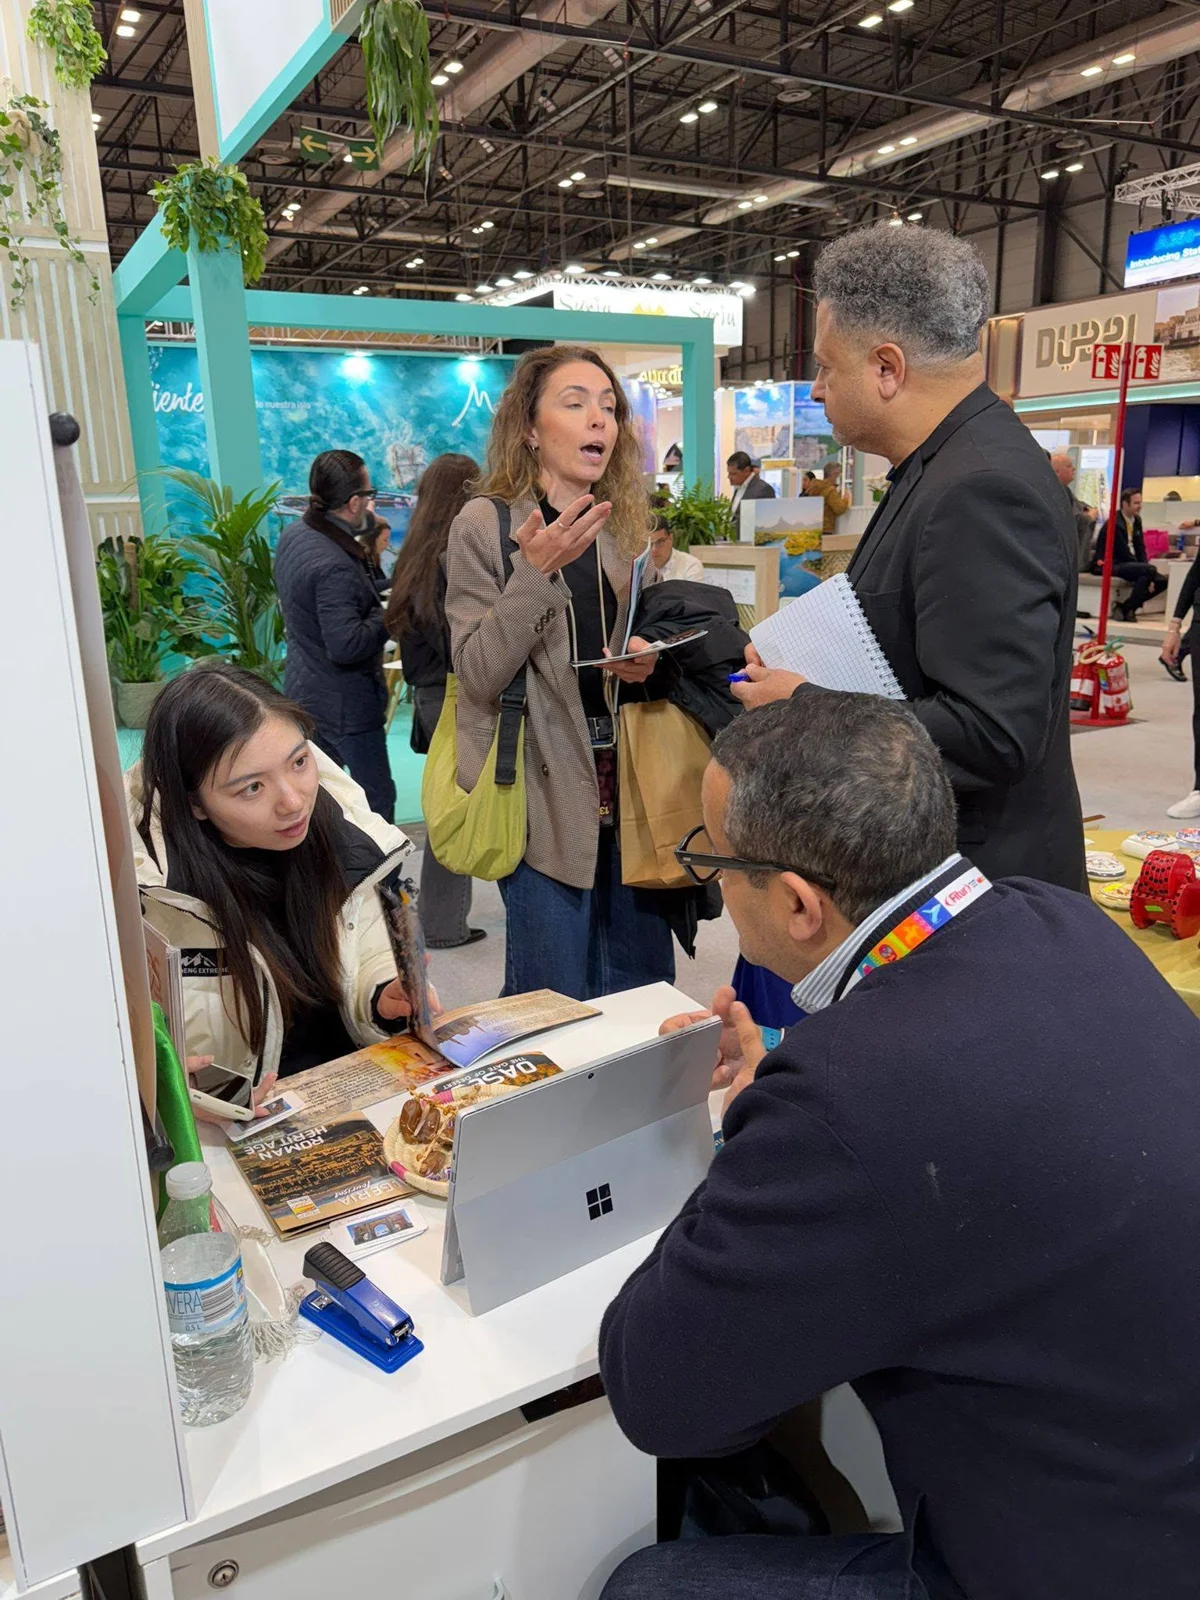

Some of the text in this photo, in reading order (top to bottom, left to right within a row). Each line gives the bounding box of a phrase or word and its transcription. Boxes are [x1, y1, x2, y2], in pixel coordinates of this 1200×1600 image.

[1130, 252, 1180, 269] Introducing
[152, 381, 204, 412] iente
[443, 1056, 527, 1090] THE GATE OF DESERT
[244, 1125, 329, 1155] HERITAGE
[258, 1138, 325, 1161] ROMAN
